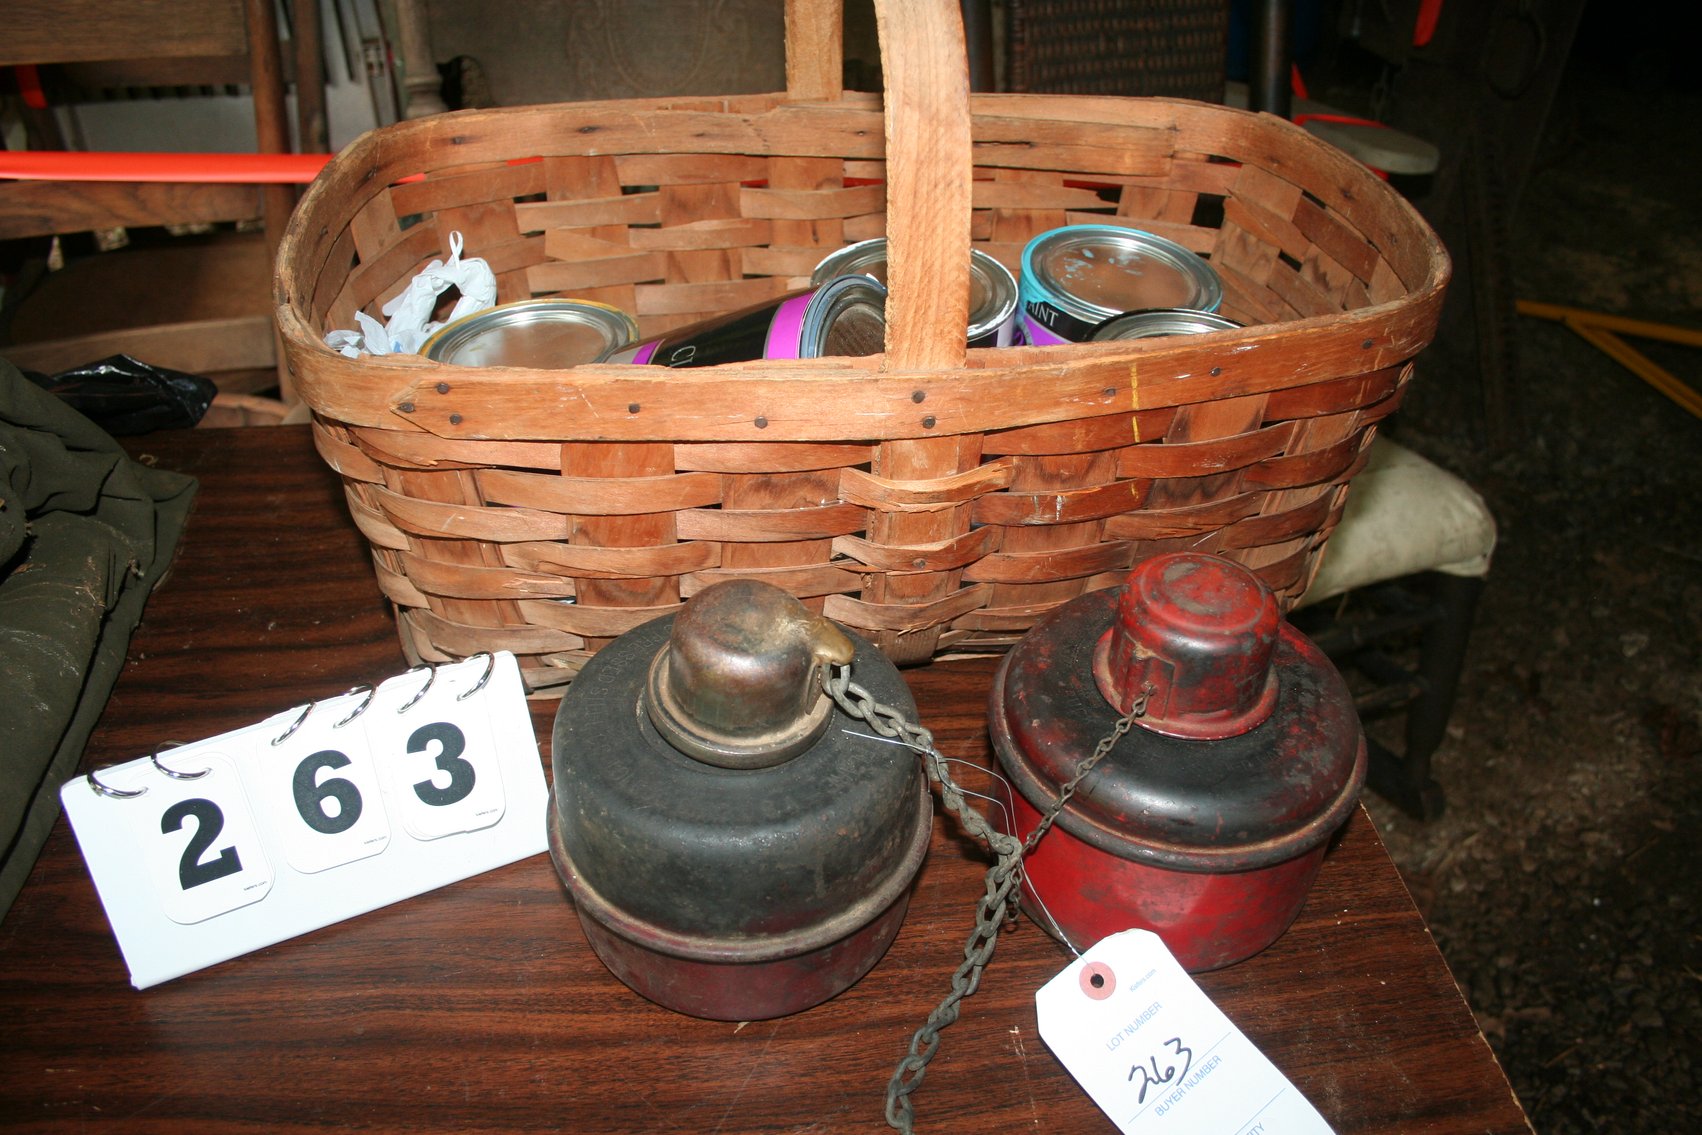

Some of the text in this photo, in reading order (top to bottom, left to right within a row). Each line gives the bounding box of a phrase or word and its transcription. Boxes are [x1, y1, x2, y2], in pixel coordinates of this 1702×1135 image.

[161, 722, 476, 890] 2 6 3
[1106, 1001, 1163, 1051] LOT NUMBER
[1127, 1037, 1192, 1104] 263
[1154, 1055, 1222, 1117] BUYER NUMBER
